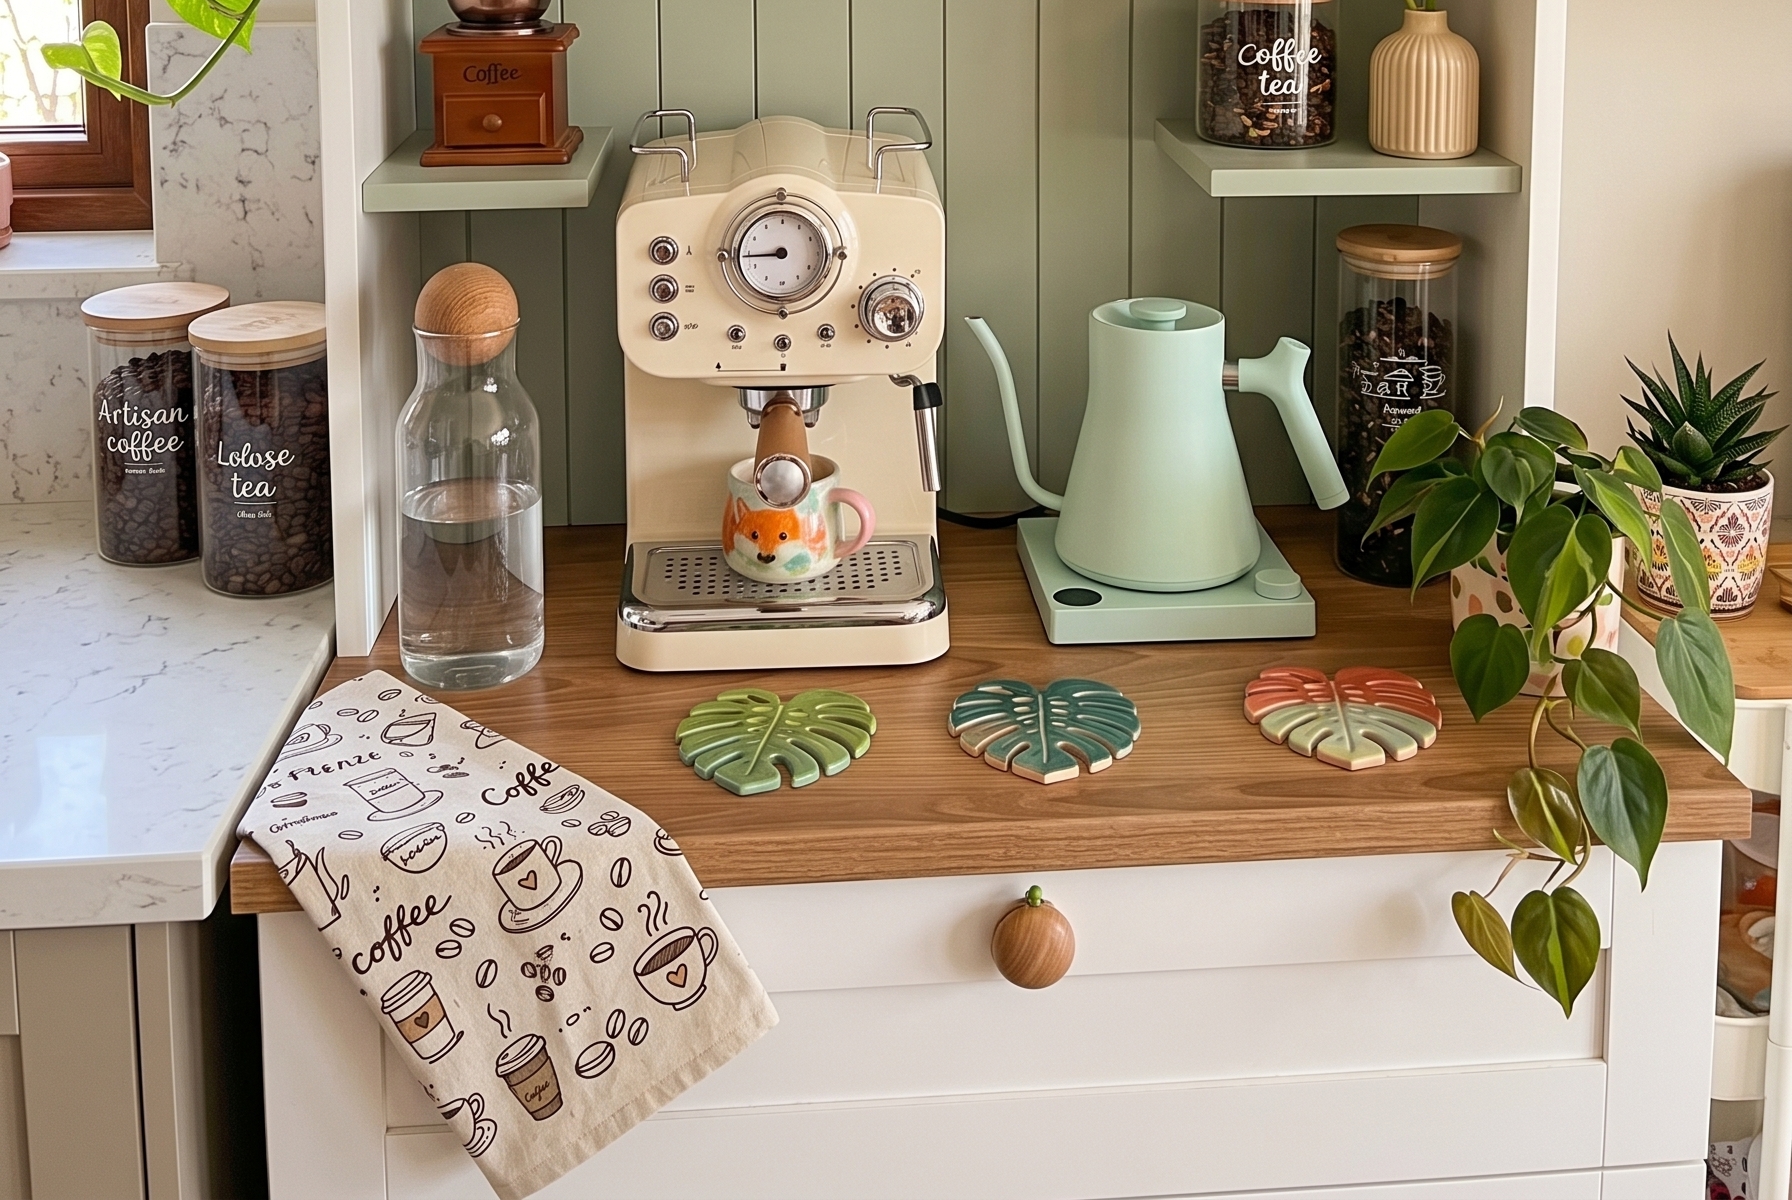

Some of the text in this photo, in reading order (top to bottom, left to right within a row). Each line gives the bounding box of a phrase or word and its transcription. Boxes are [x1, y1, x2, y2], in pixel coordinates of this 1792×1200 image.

[1238, 38, 1322, 72] Coffee
[463, 62, 522, 86] Coffee
[1258, 69, 1304, 97] tea
[98, 399, 189, 429] Artisan
[106, 431, 185, 462] coffee
[217, 440, 295, 471] Lolose
[230, 472, 277, 498] tea
[481, 761, 561, 806] Coffe
[352, 892, 452, 976] coffee
